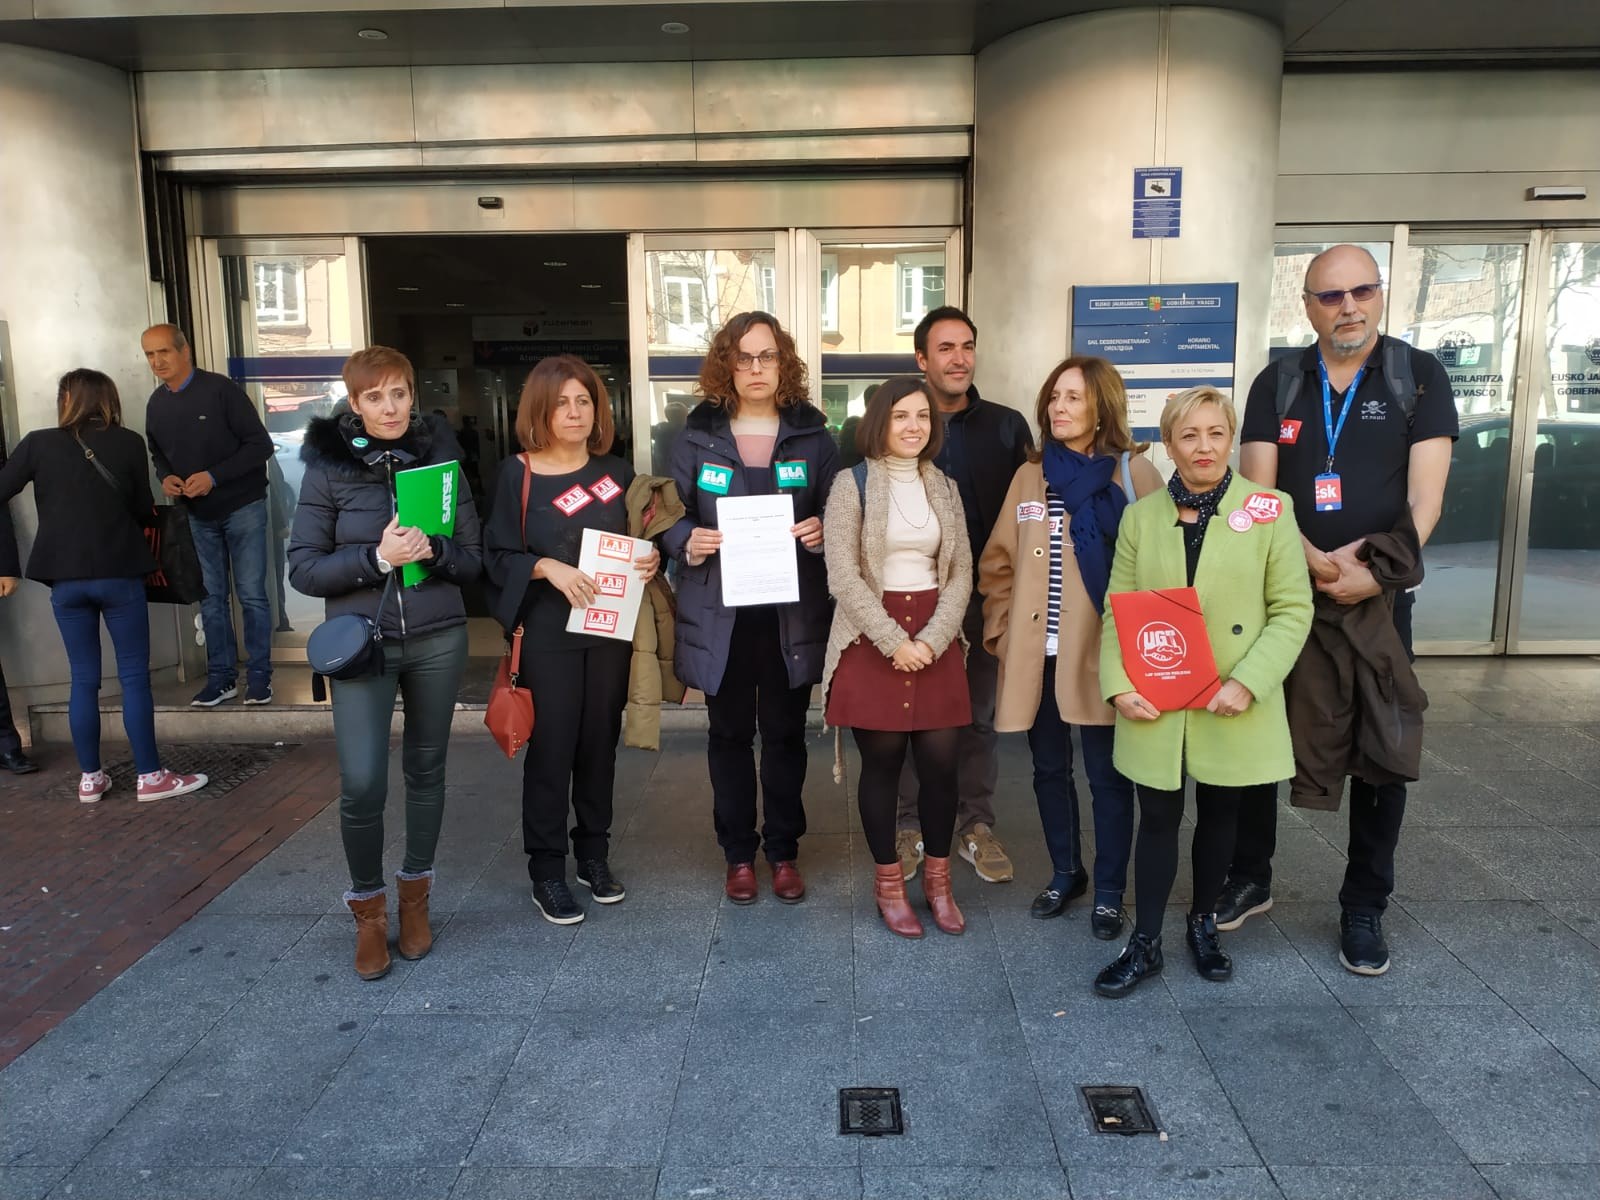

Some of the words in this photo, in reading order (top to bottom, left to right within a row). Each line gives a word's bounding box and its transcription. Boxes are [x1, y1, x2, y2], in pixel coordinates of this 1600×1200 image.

[1450, 374, 1504, 383] URLARITZA
[1551, 373, 1585, 381] EUSKO
[1463, 389, 1497, 397] VASCO
[1557, 387, 1600, 396] GOBIERN
[702, 469, 727, 488] ELA
[778, 466, 806, 481] ELA
[600, 478, 614, 495] LAB
[442, 470, 453, 524] SATSE
[559, 489, 585, 509] LAB
[603, 538, 630, 554] LAB
[598, 576, 624, 589] LAB
[588, 612, 615, 625] LAB
[1143, 630, 1176, 650] UGT
